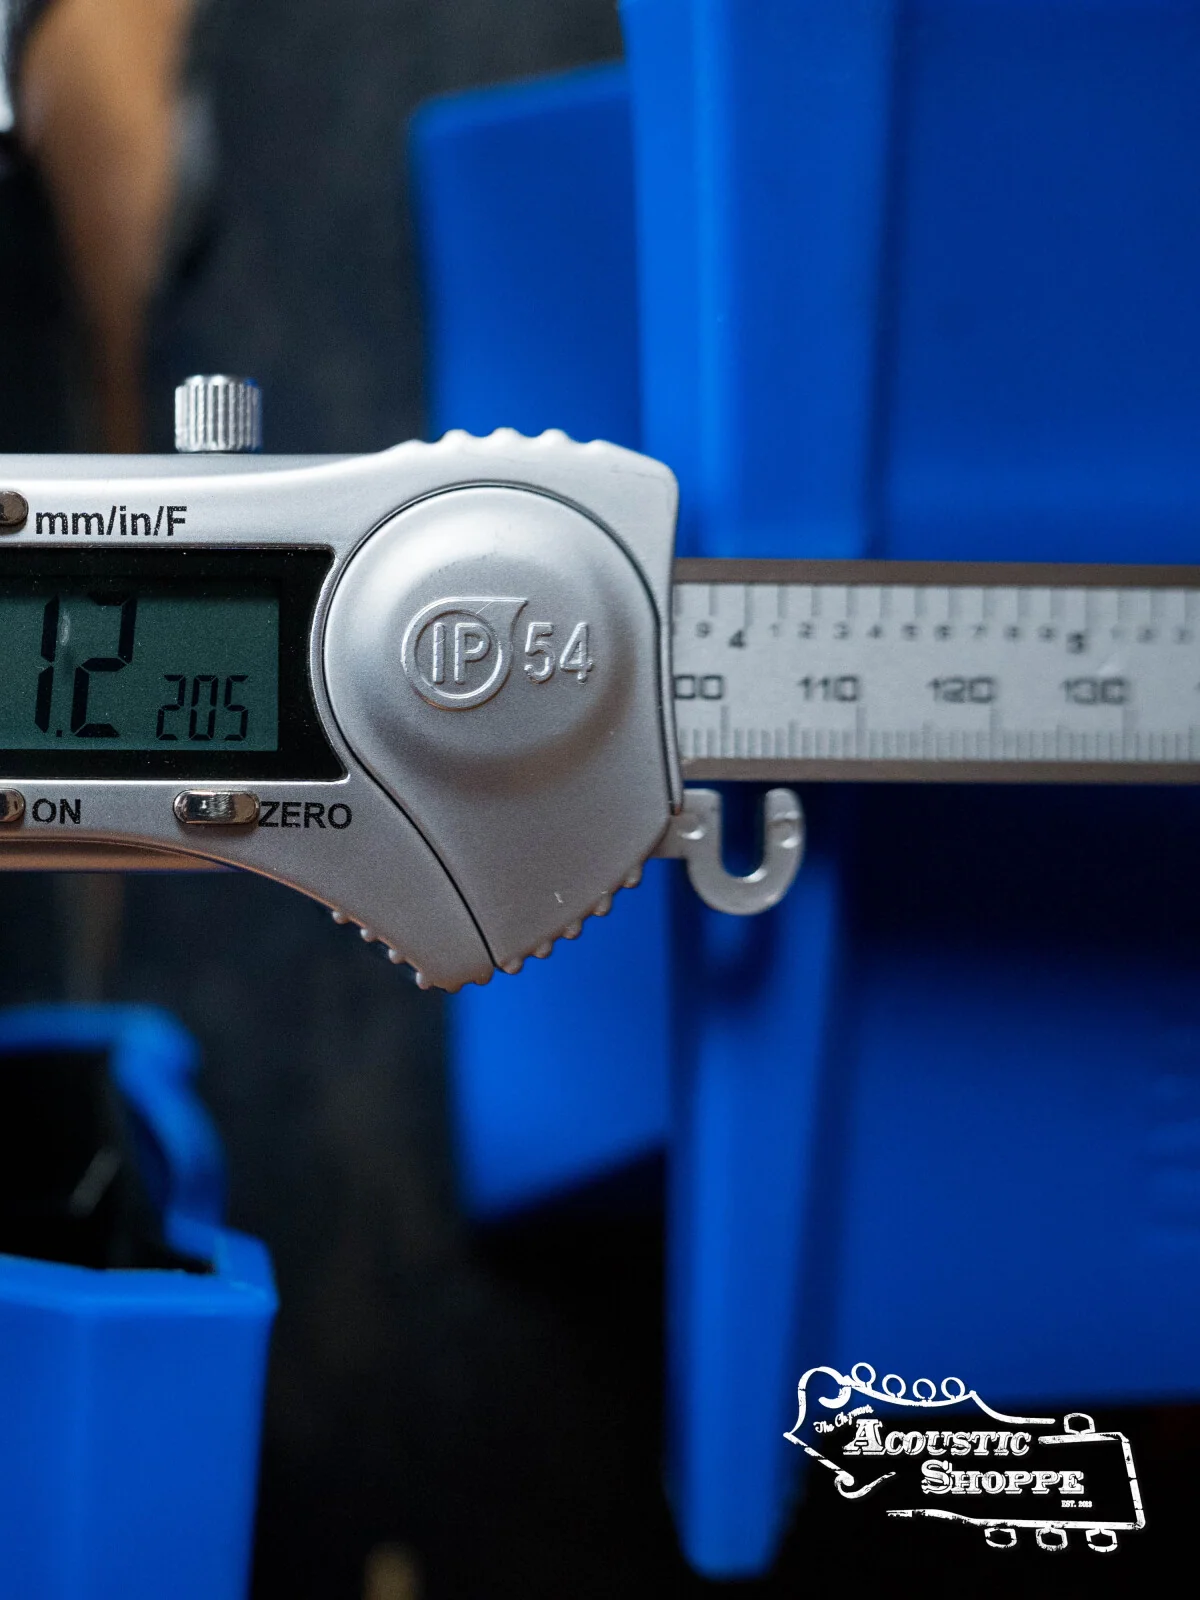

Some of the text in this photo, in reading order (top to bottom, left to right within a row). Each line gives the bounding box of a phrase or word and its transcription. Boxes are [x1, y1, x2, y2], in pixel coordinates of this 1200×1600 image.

[35, 505, 188, 537] mm/in/F
[432, 622, 594, 685] IP 54
[674, 674, 724, 701] 00
[798, 674, 861, 703] 110
[927, 676, 998, 705] 120
[31, 797, 82, 825] ON
[258, 800, 353, 830] ZERO
